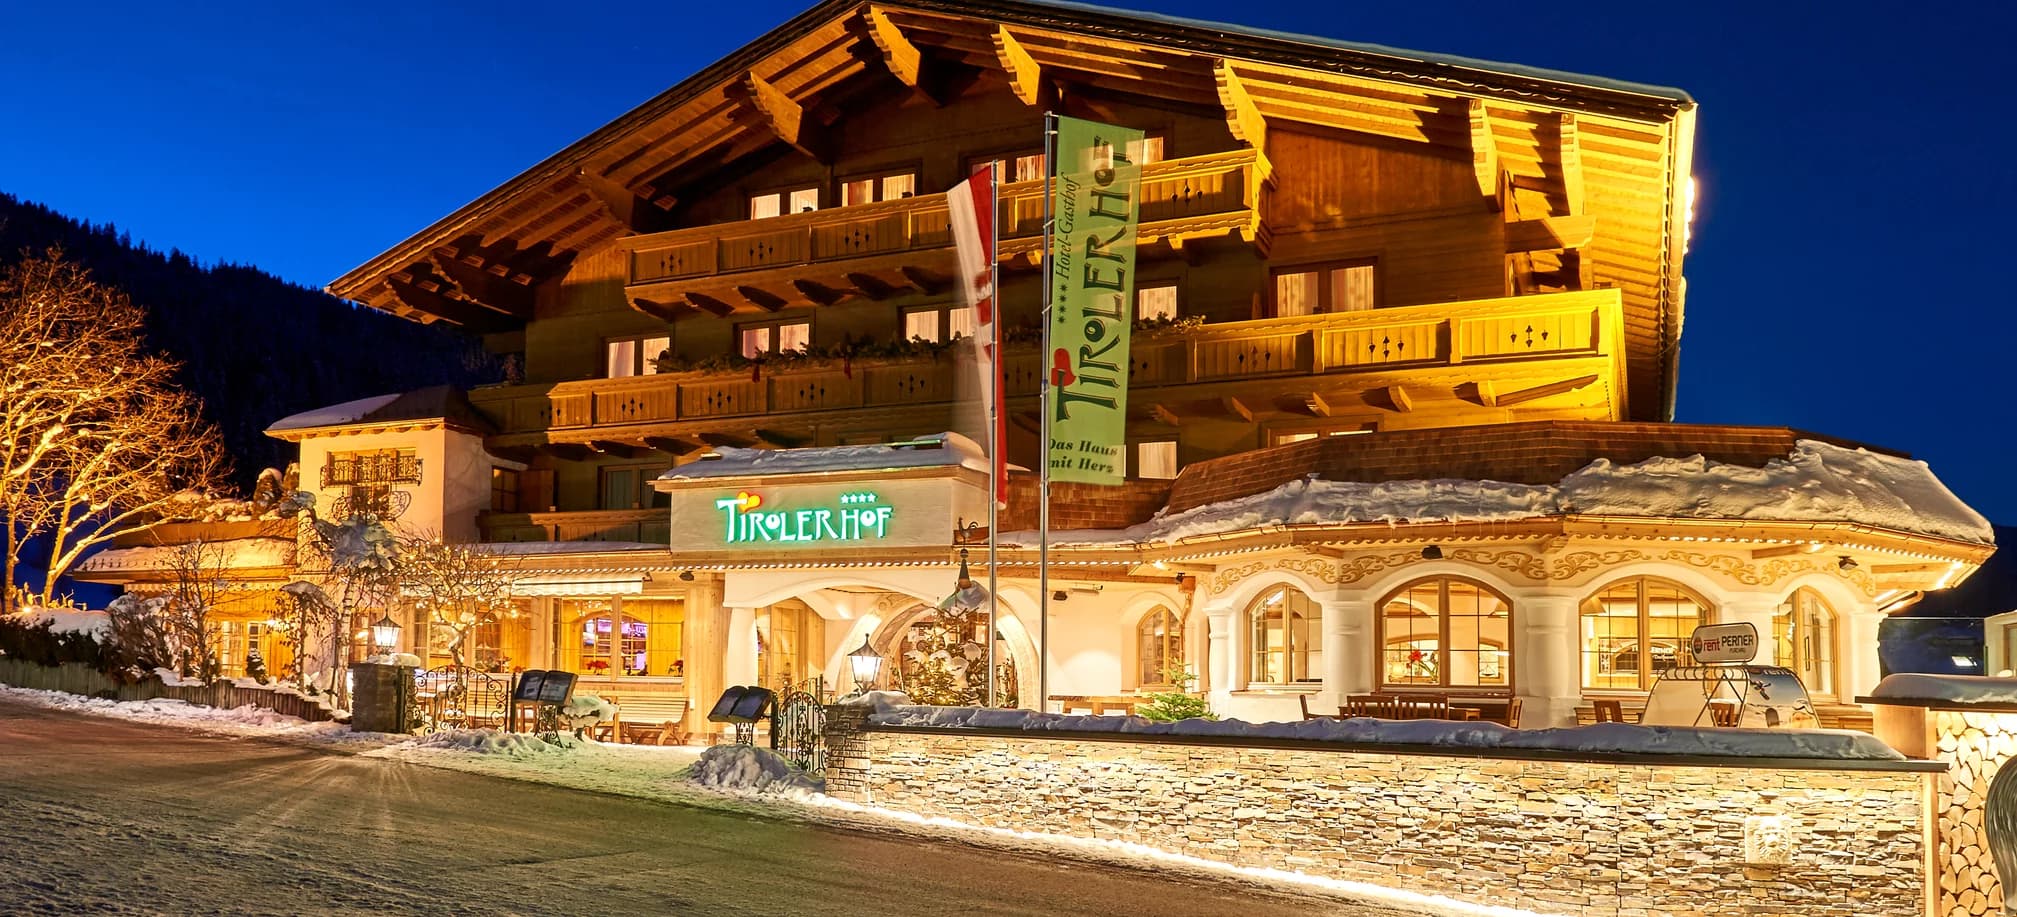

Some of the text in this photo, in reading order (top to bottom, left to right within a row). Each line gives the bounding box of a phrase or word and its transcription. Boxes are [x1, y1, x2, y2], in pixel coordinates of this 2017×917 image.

[1055, 172, 1081, 281] Hotel-Gasthof
[1079, 440, 1118, 456] Haus
[1078, 457, 1114, 473] Herz
[1703, 638, 1720, 651] rent
[1721, 634, 1754, 647] PERNER
